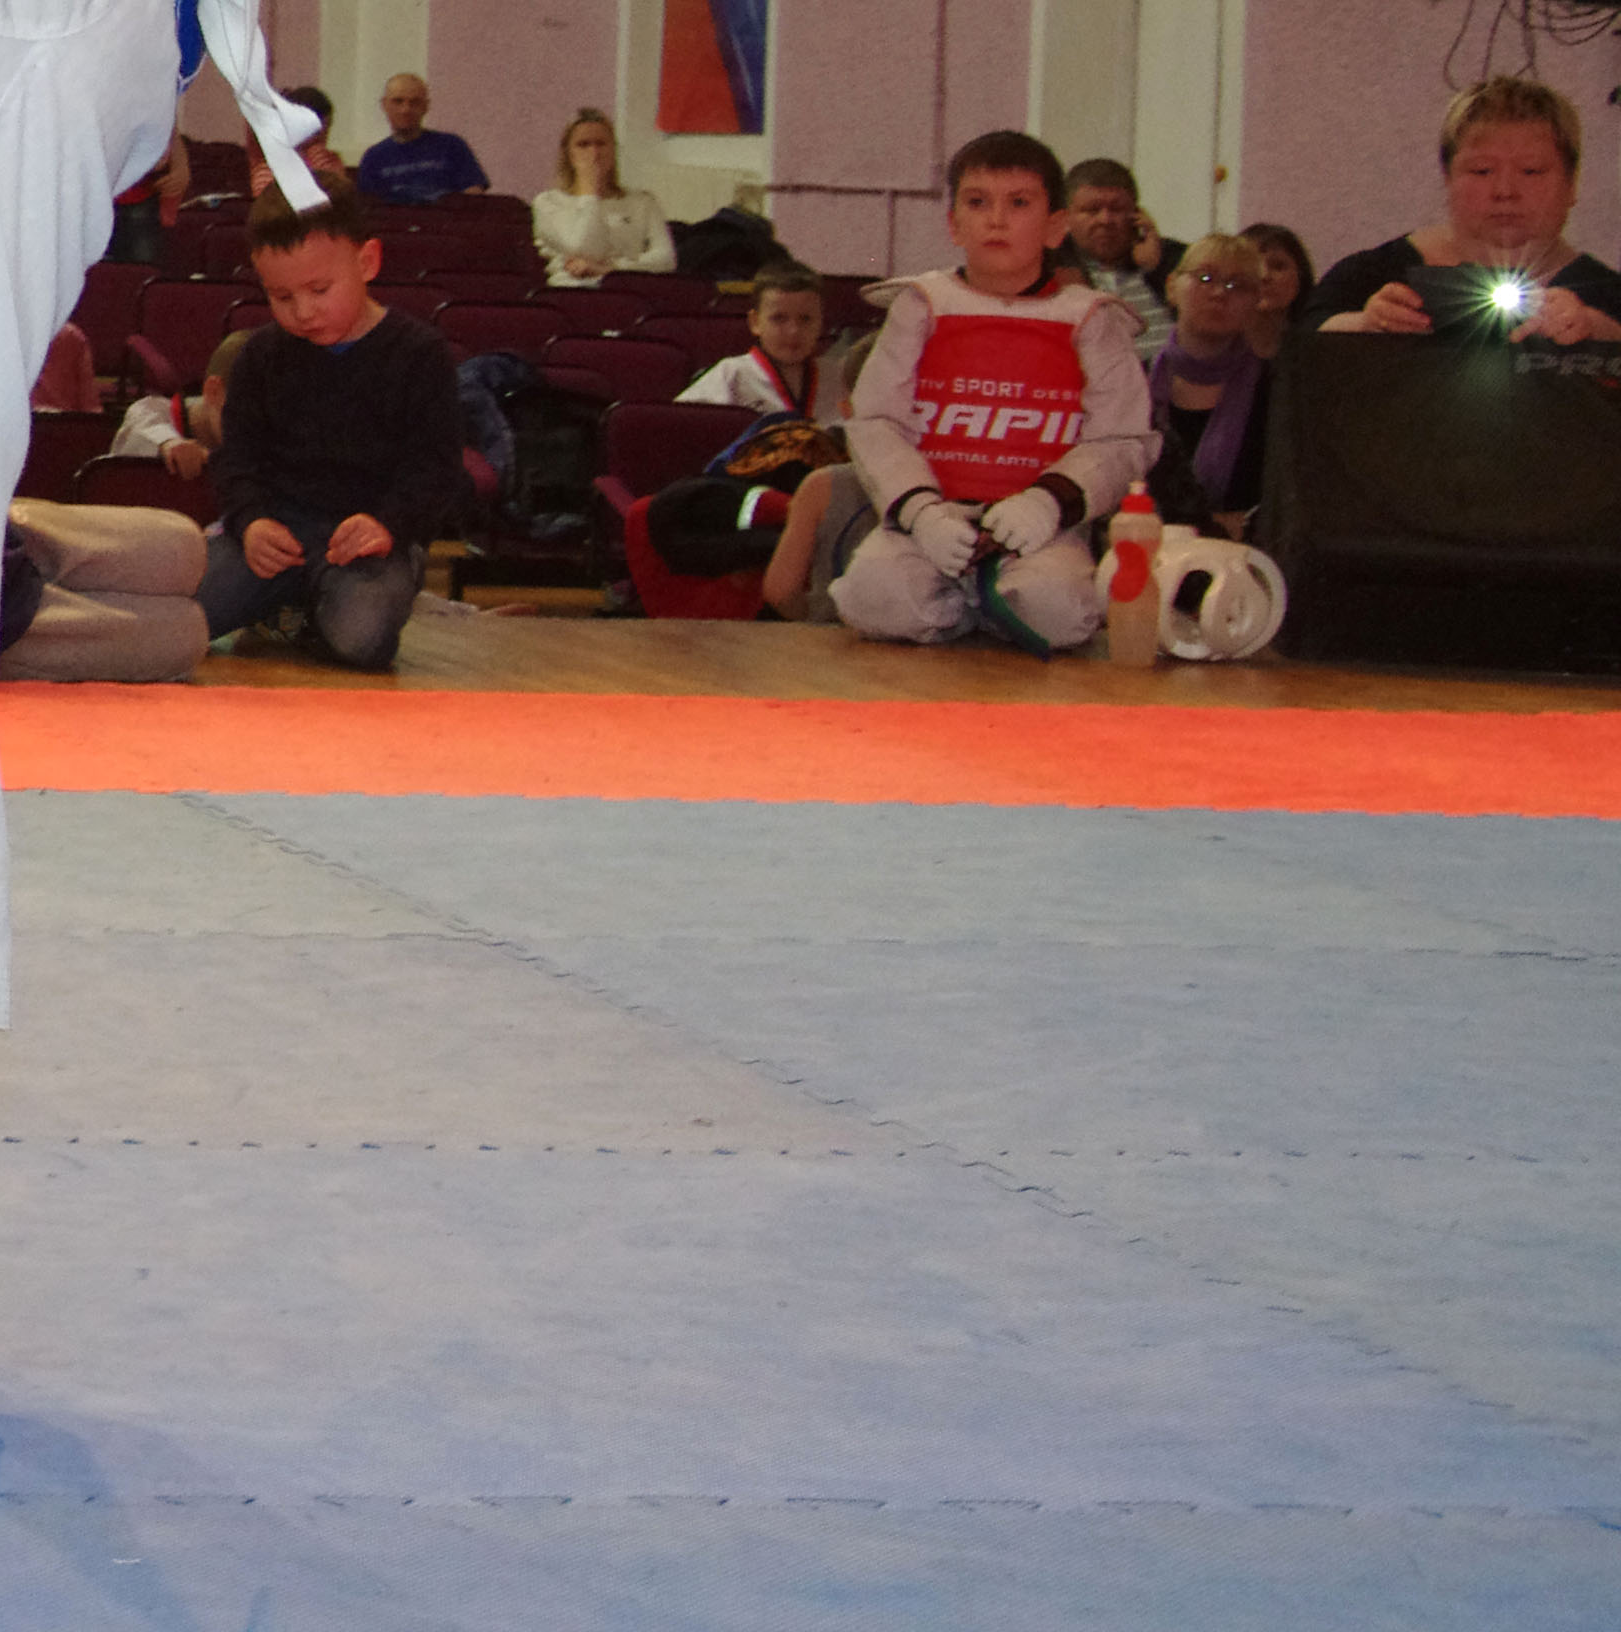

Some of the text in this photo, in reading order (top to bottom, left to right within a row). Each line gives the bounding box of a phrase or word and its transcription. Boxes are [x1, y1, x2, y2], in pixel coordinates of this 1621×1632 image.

[1514, 352, 1621, 377] PR
[919, 377, 1080, 400] TIV SPORT DESI
[995, 456, 1040, 468] ARTS
